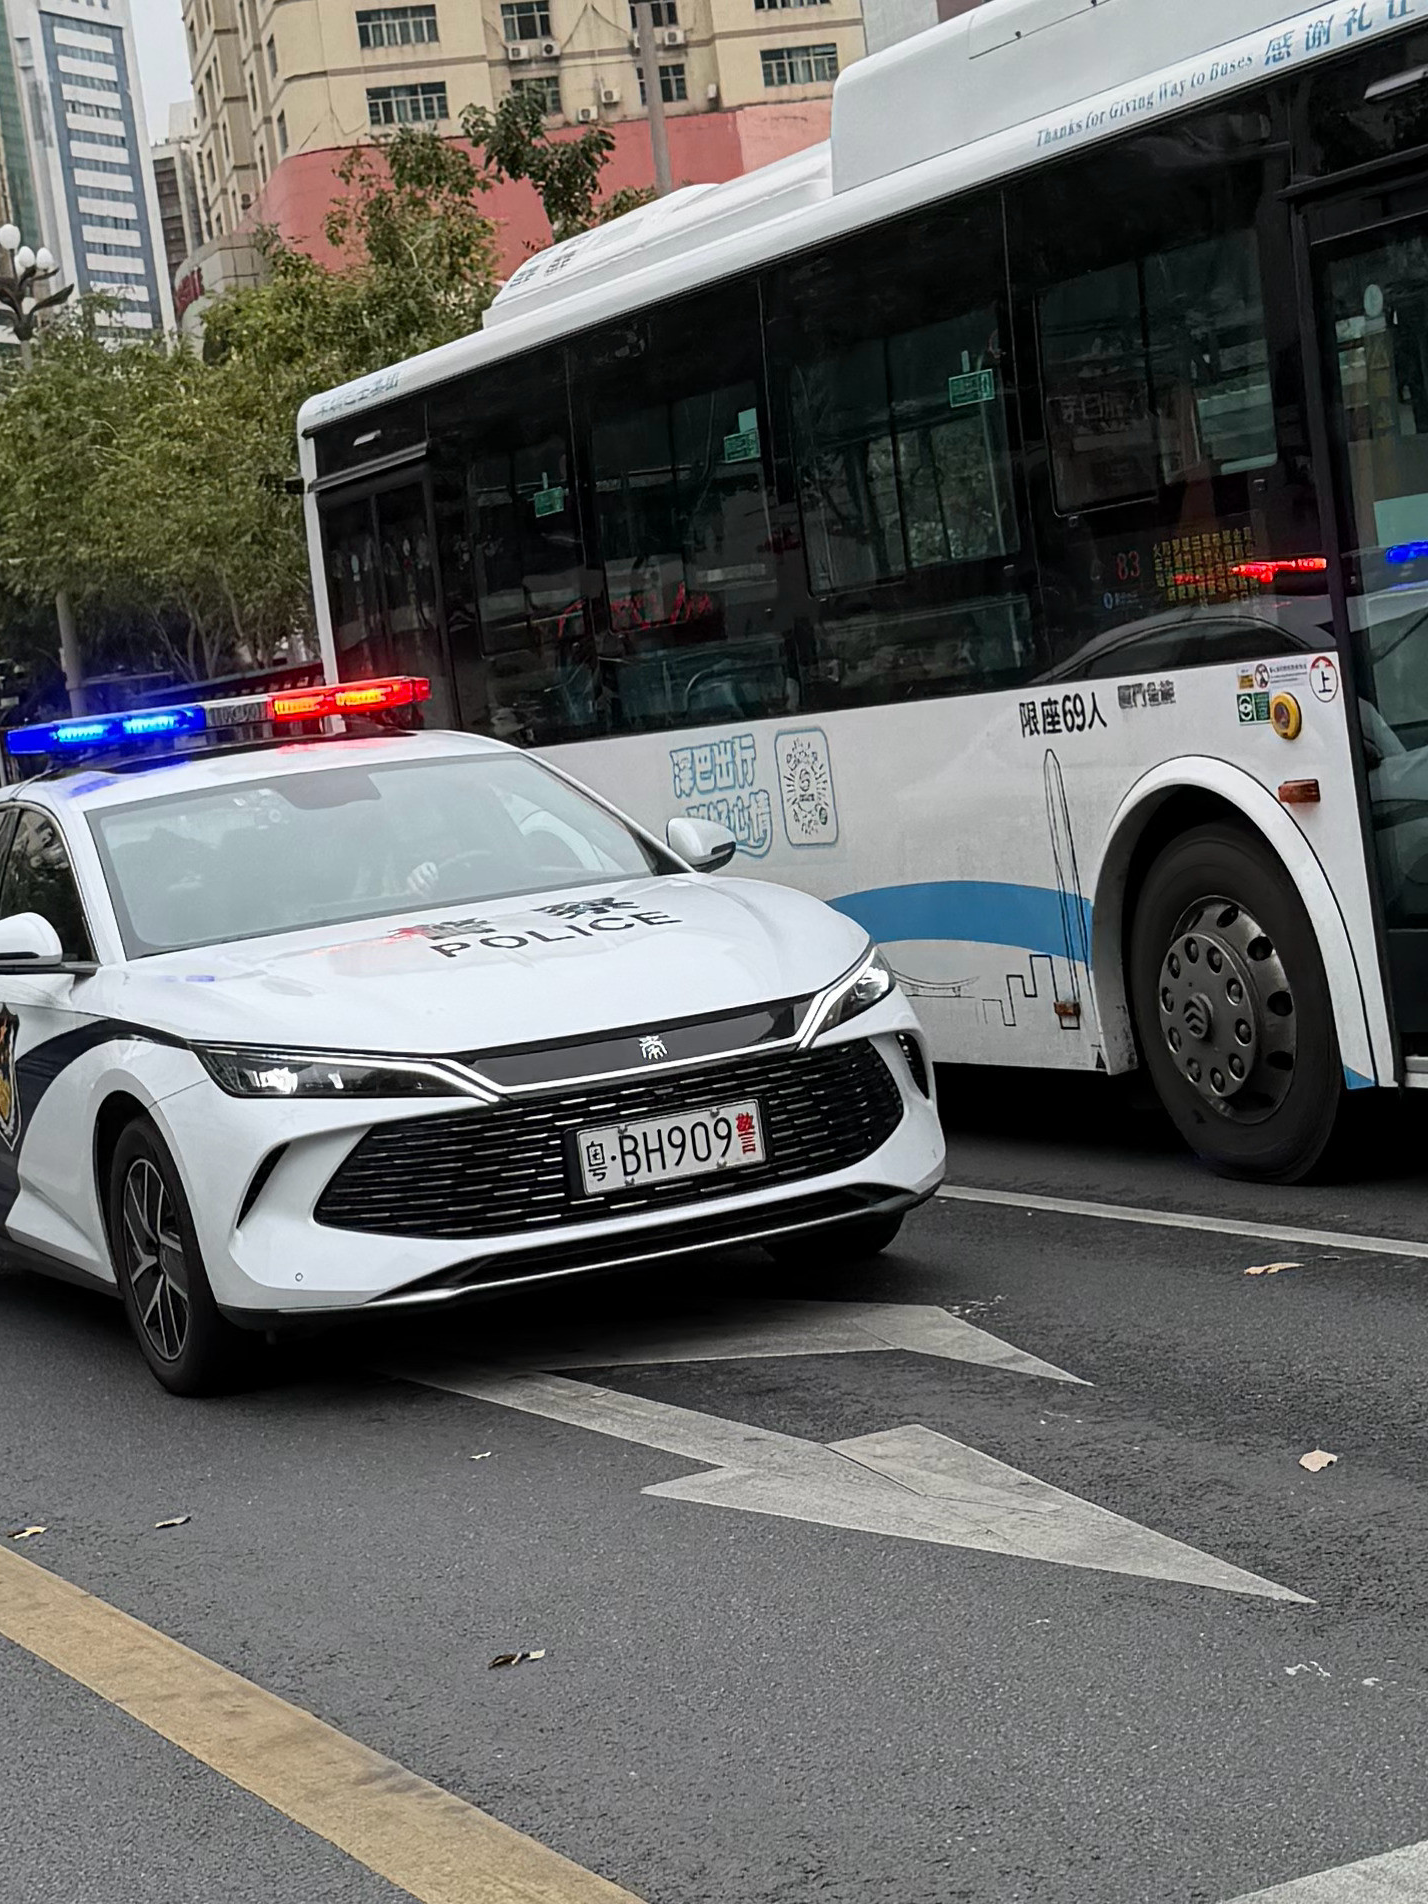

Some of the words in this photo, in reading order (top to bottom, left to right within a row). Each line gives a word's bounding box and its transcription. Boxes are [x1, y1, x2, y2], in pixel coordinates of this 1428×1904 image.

[1036, 121, 1083, 148] Thanks
[1085, 110, 1106, 130] for
[1109, 90, 1155, 120] Giving
[1157, 78, 1187, 103] Way
[1190, 70, 1206, 89] to
[1208, 53, 1255, 82] Buses
[1019, 691, 1108, 738] 限座69人
[429, 910, 683, 958] POLICE
